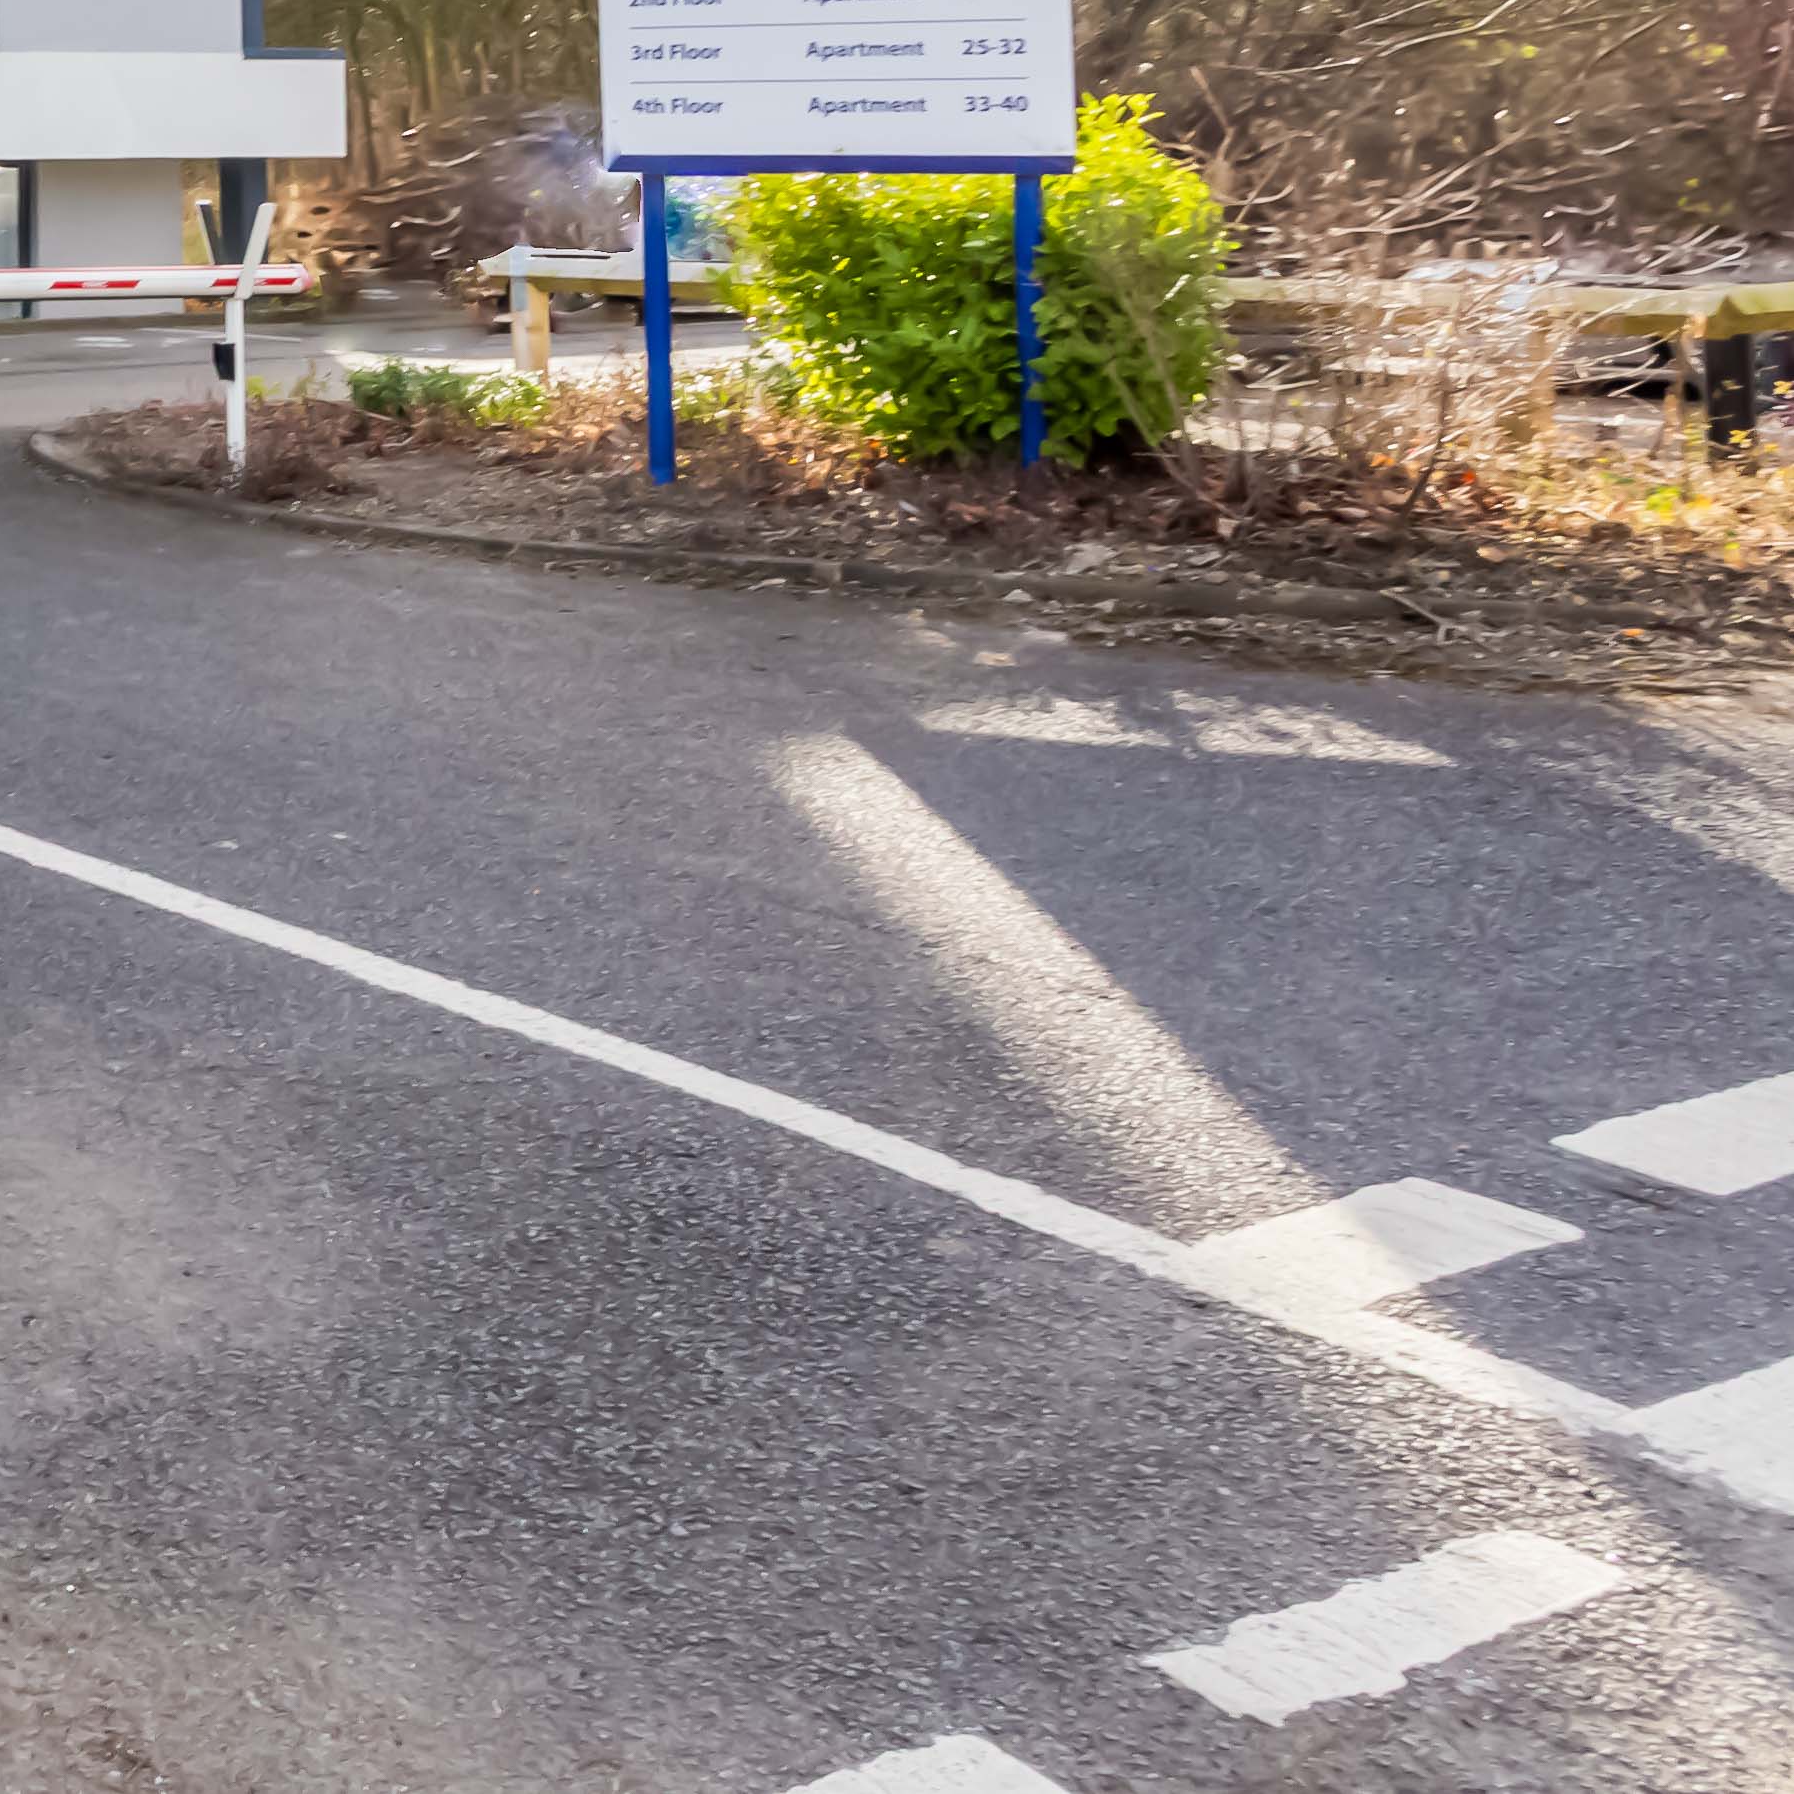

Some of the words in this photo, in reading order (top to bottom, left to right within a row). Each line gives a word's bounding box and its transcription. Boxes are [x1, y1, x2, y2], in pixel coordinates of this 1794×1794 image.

[631, 44, 664, 60] 3rd
[669, 44, 722, 60] Floor
[806, 42, 924, 62] Apartment
[962, 38, 1027, 55] 25-32
[632, 98, 665, 113] 4th
[671, 98, 724, 114] Floor
[808, 97, 927, 117] Apartment
[964, 96, 1028, 112] 33-40
